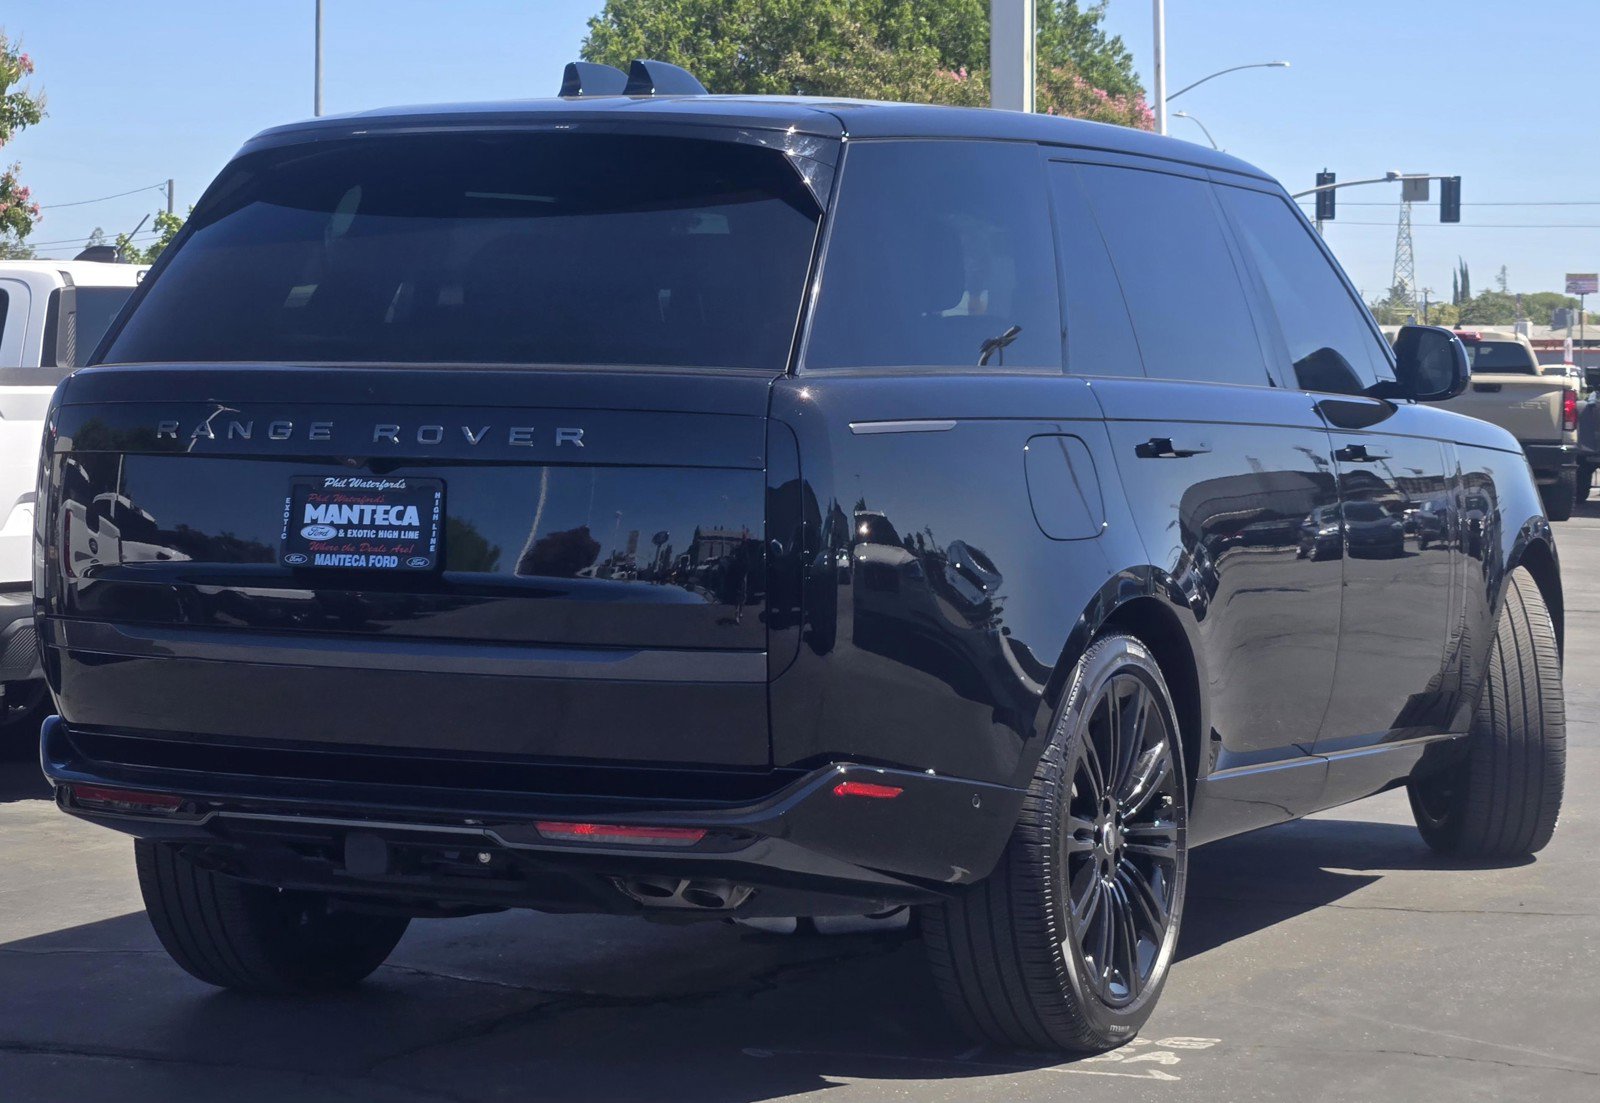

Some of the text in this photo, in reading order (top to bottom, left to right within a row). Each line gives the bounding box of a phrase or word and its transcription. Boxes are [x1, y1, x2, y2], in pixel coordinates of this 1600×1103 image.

[156, 419, 586, 447] RANGE ROVER
[324, 477, 407, 490] Phil Waterford's
[280, 497, 291, 540] EXOTIC
[304, 504, 420, 526] MANTECA
[429, 491, 441, 552] HIGH LINE
[307, 526, 420, 540] Ford & EXOTIC HIGH LINE
[309, 541, 340, 552] Where
[314, 553, 399, 568] MANTECA FORD
